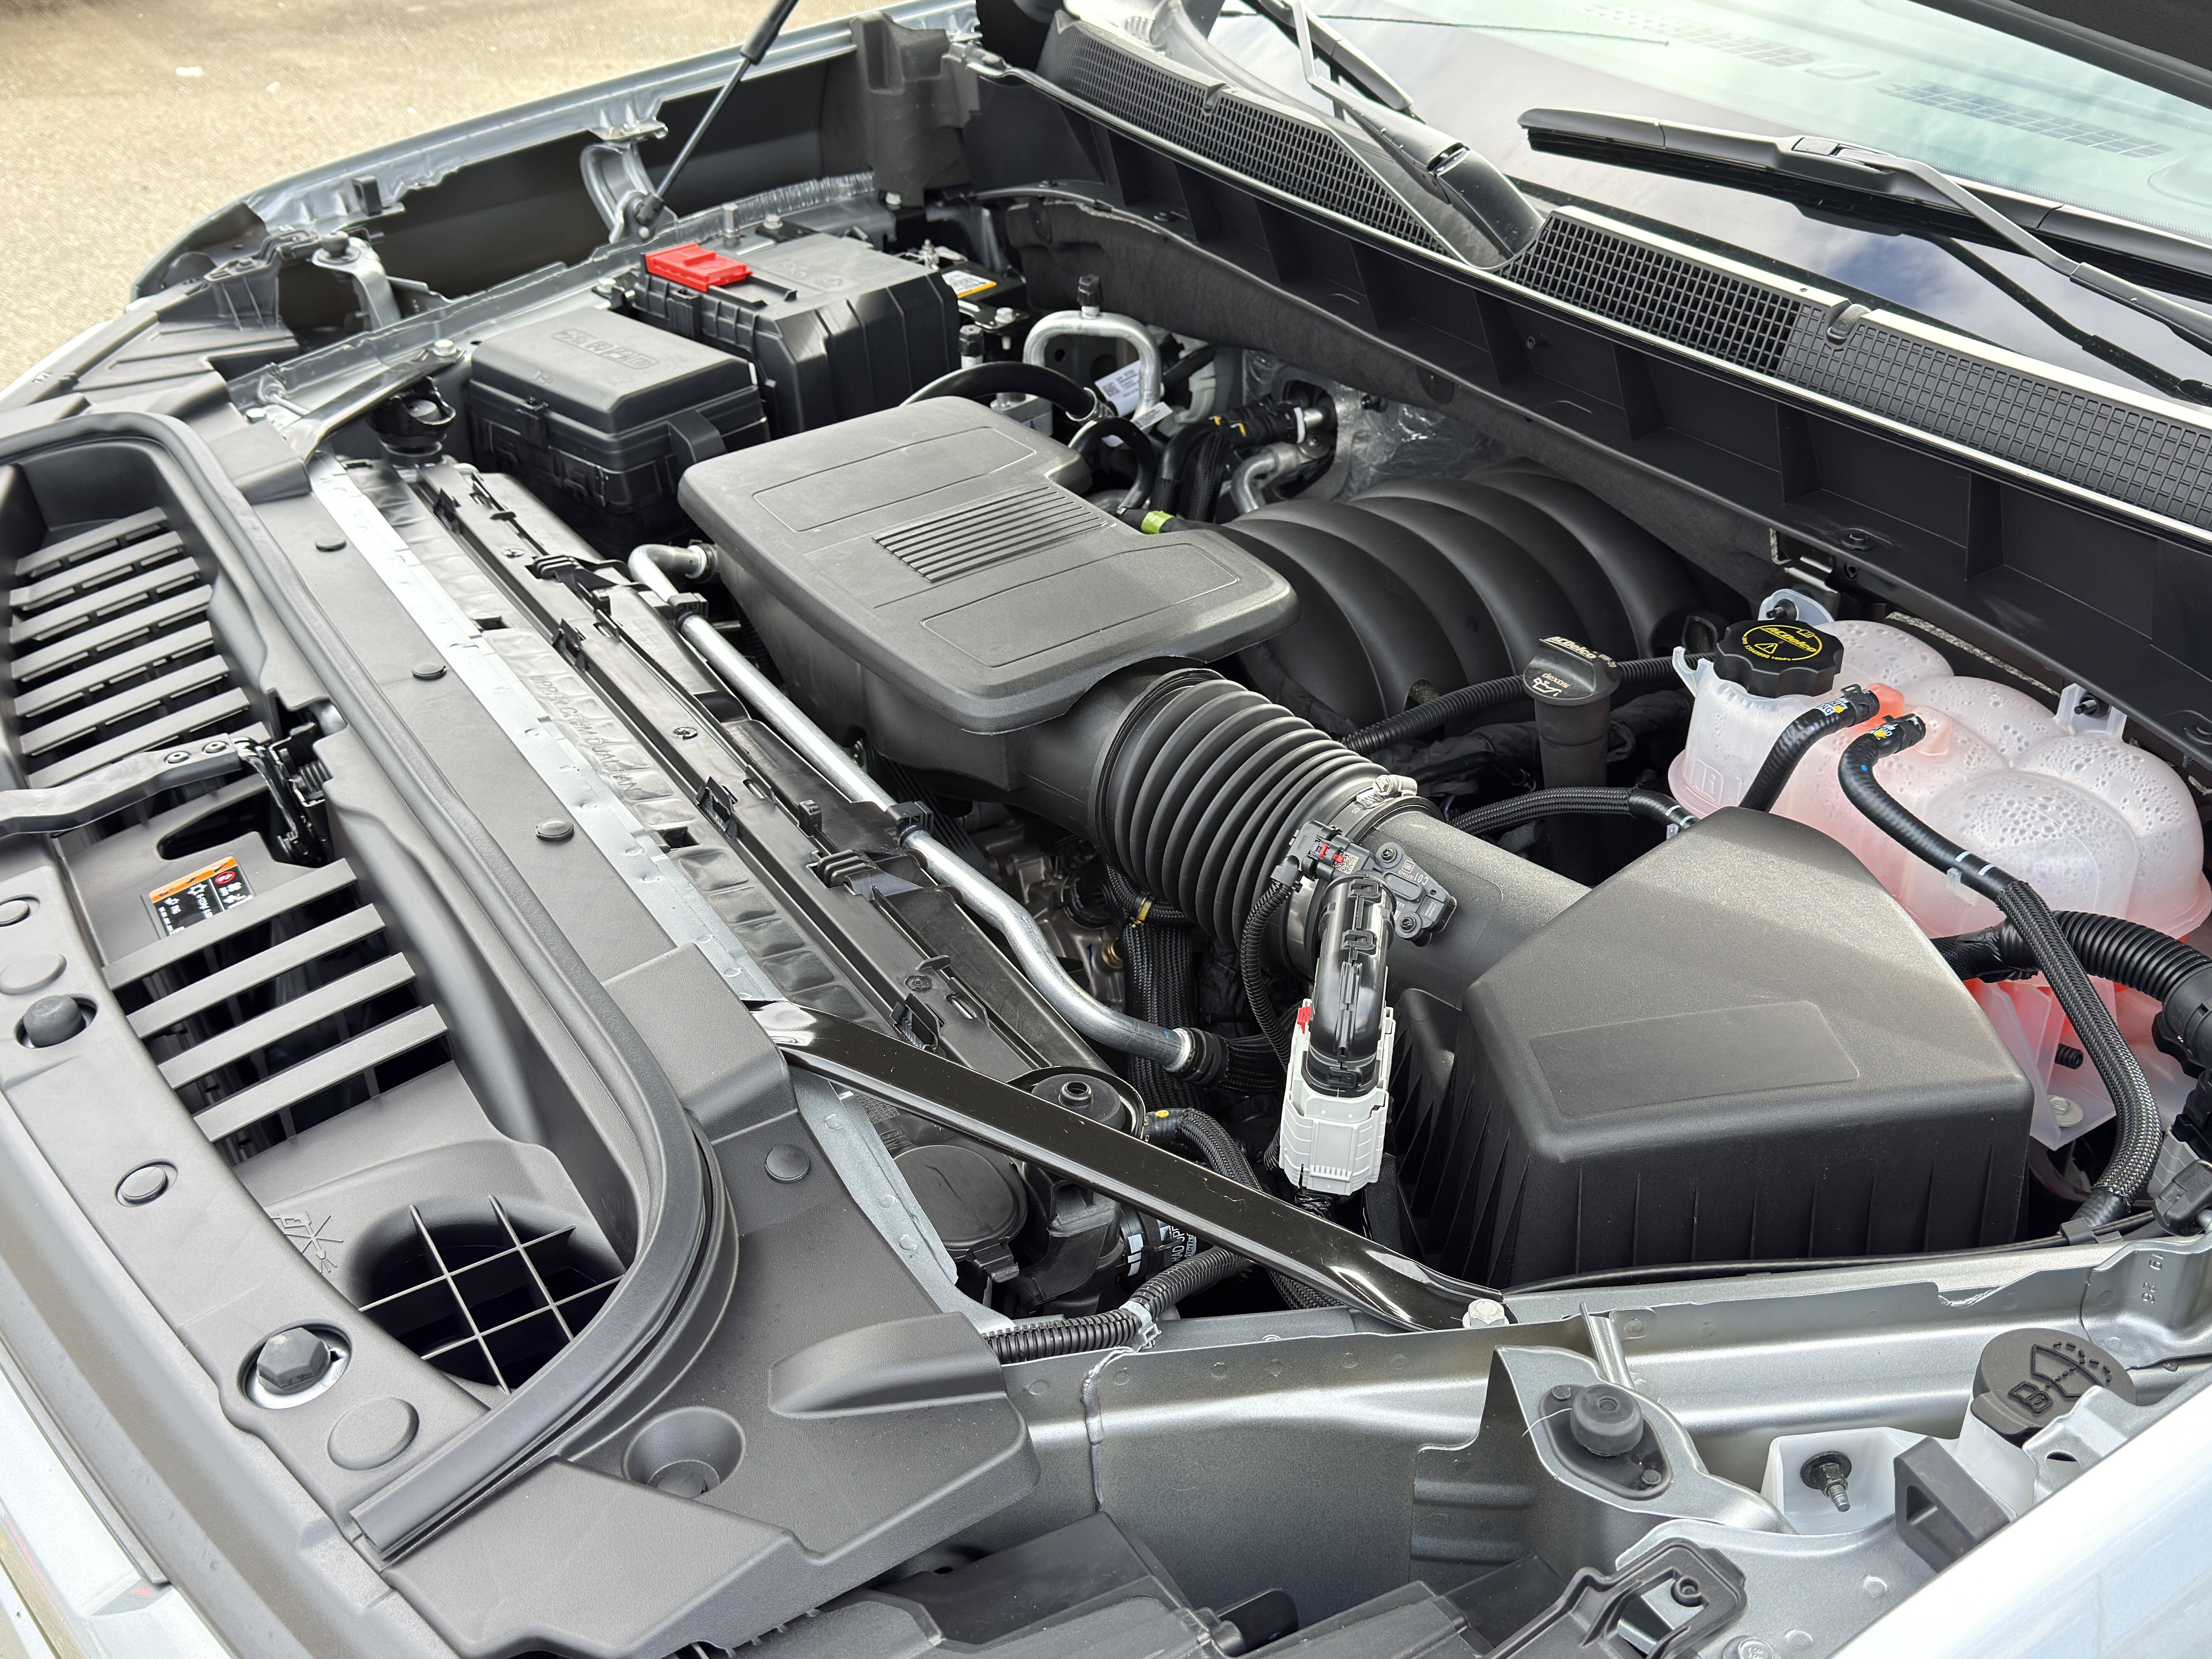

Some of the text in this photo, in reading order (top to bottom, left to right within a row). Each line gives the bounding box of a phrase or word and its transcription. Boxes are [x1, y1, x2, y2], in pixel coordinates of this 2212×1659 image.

[1545, 636, 1596, 659] ACDelco
[1764, 628, 1817, 652] ACDelco
[1542, 673, 1570, 688] dexos
[585, 737, 620, 768] DUAL
[879, 1128, 911, 1152] GM
[2141, 1282, 2157, 1304] 26
